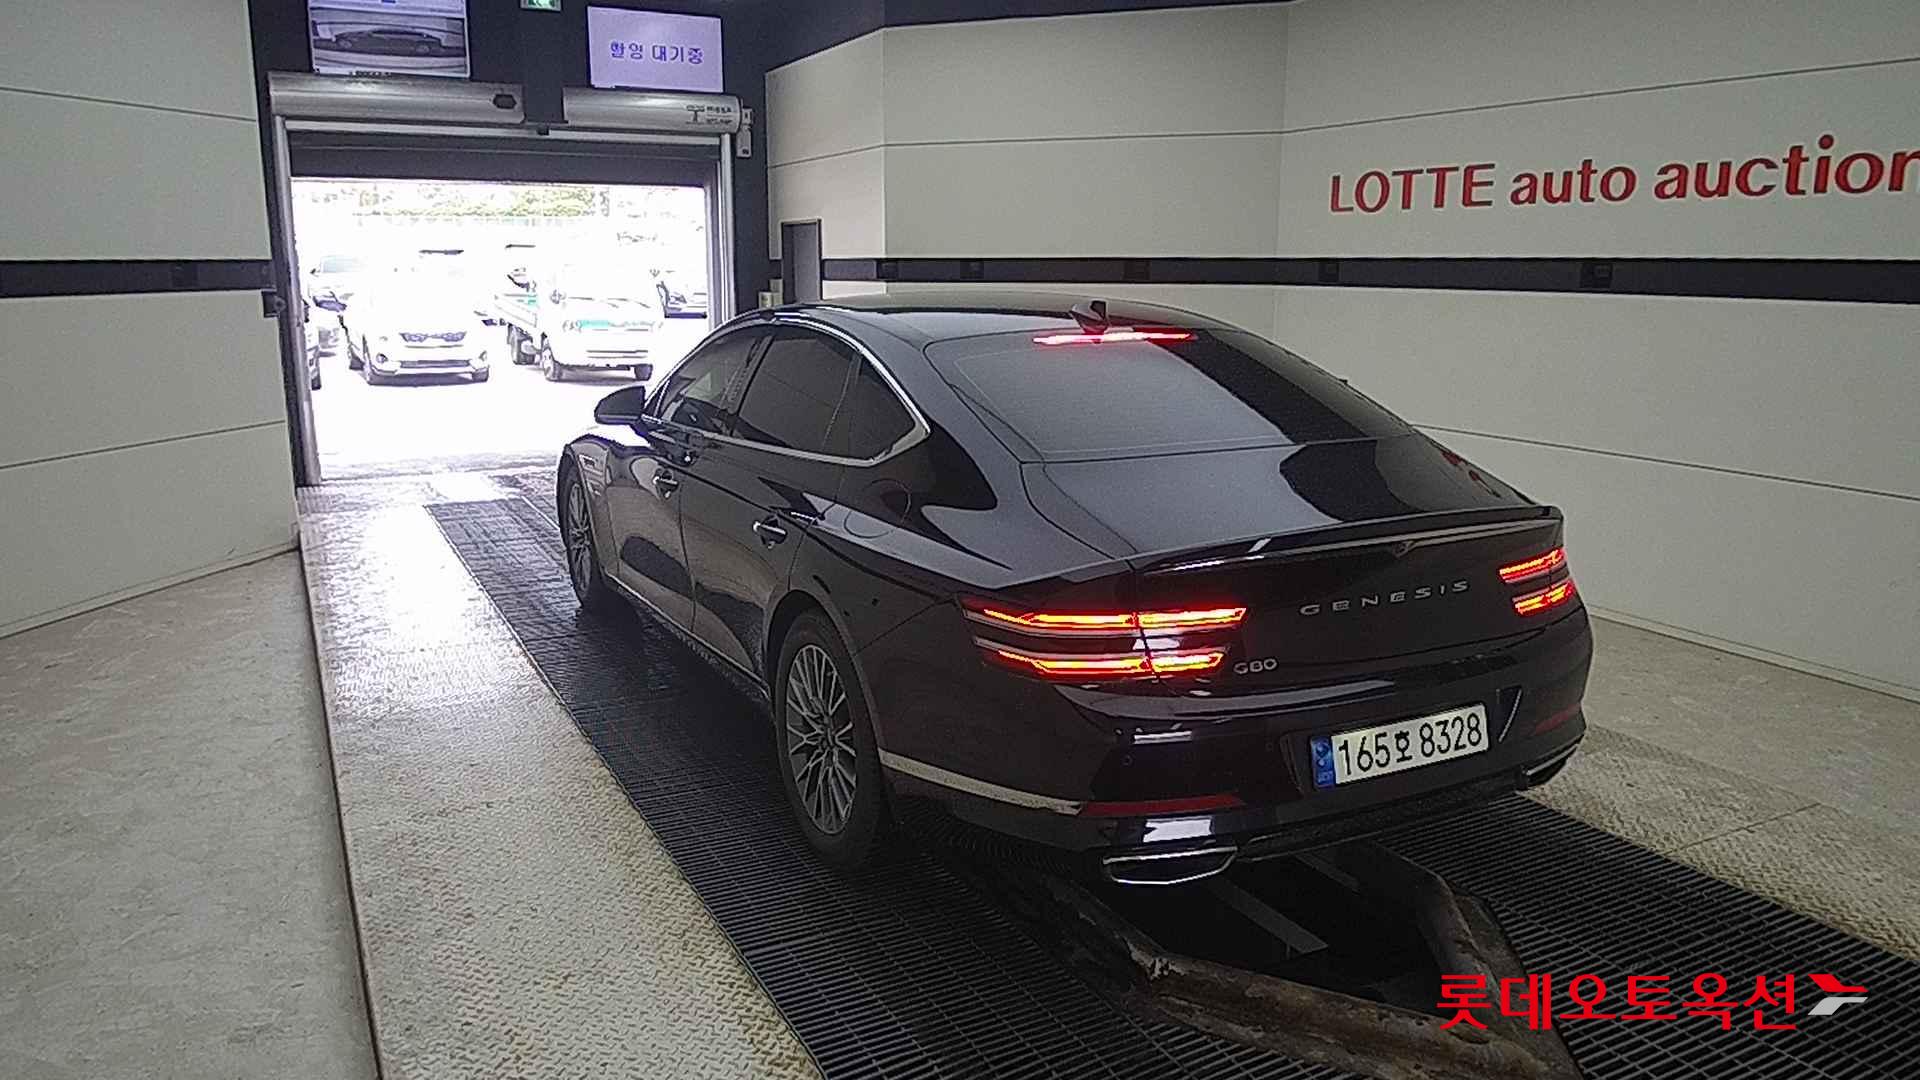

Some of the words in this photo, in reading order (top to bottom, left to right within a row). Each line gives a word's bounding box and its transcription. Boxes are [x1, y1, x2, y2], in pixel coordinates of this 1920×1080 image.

[651, 45, 703, 65] 대기중
[1331, 163, 1496, 213] LOTTE
[1509, 159, 1637, 206] auto
[1299, 580, 1470, 616] GENESIS
[1233, 657, 1278, 676] G80
